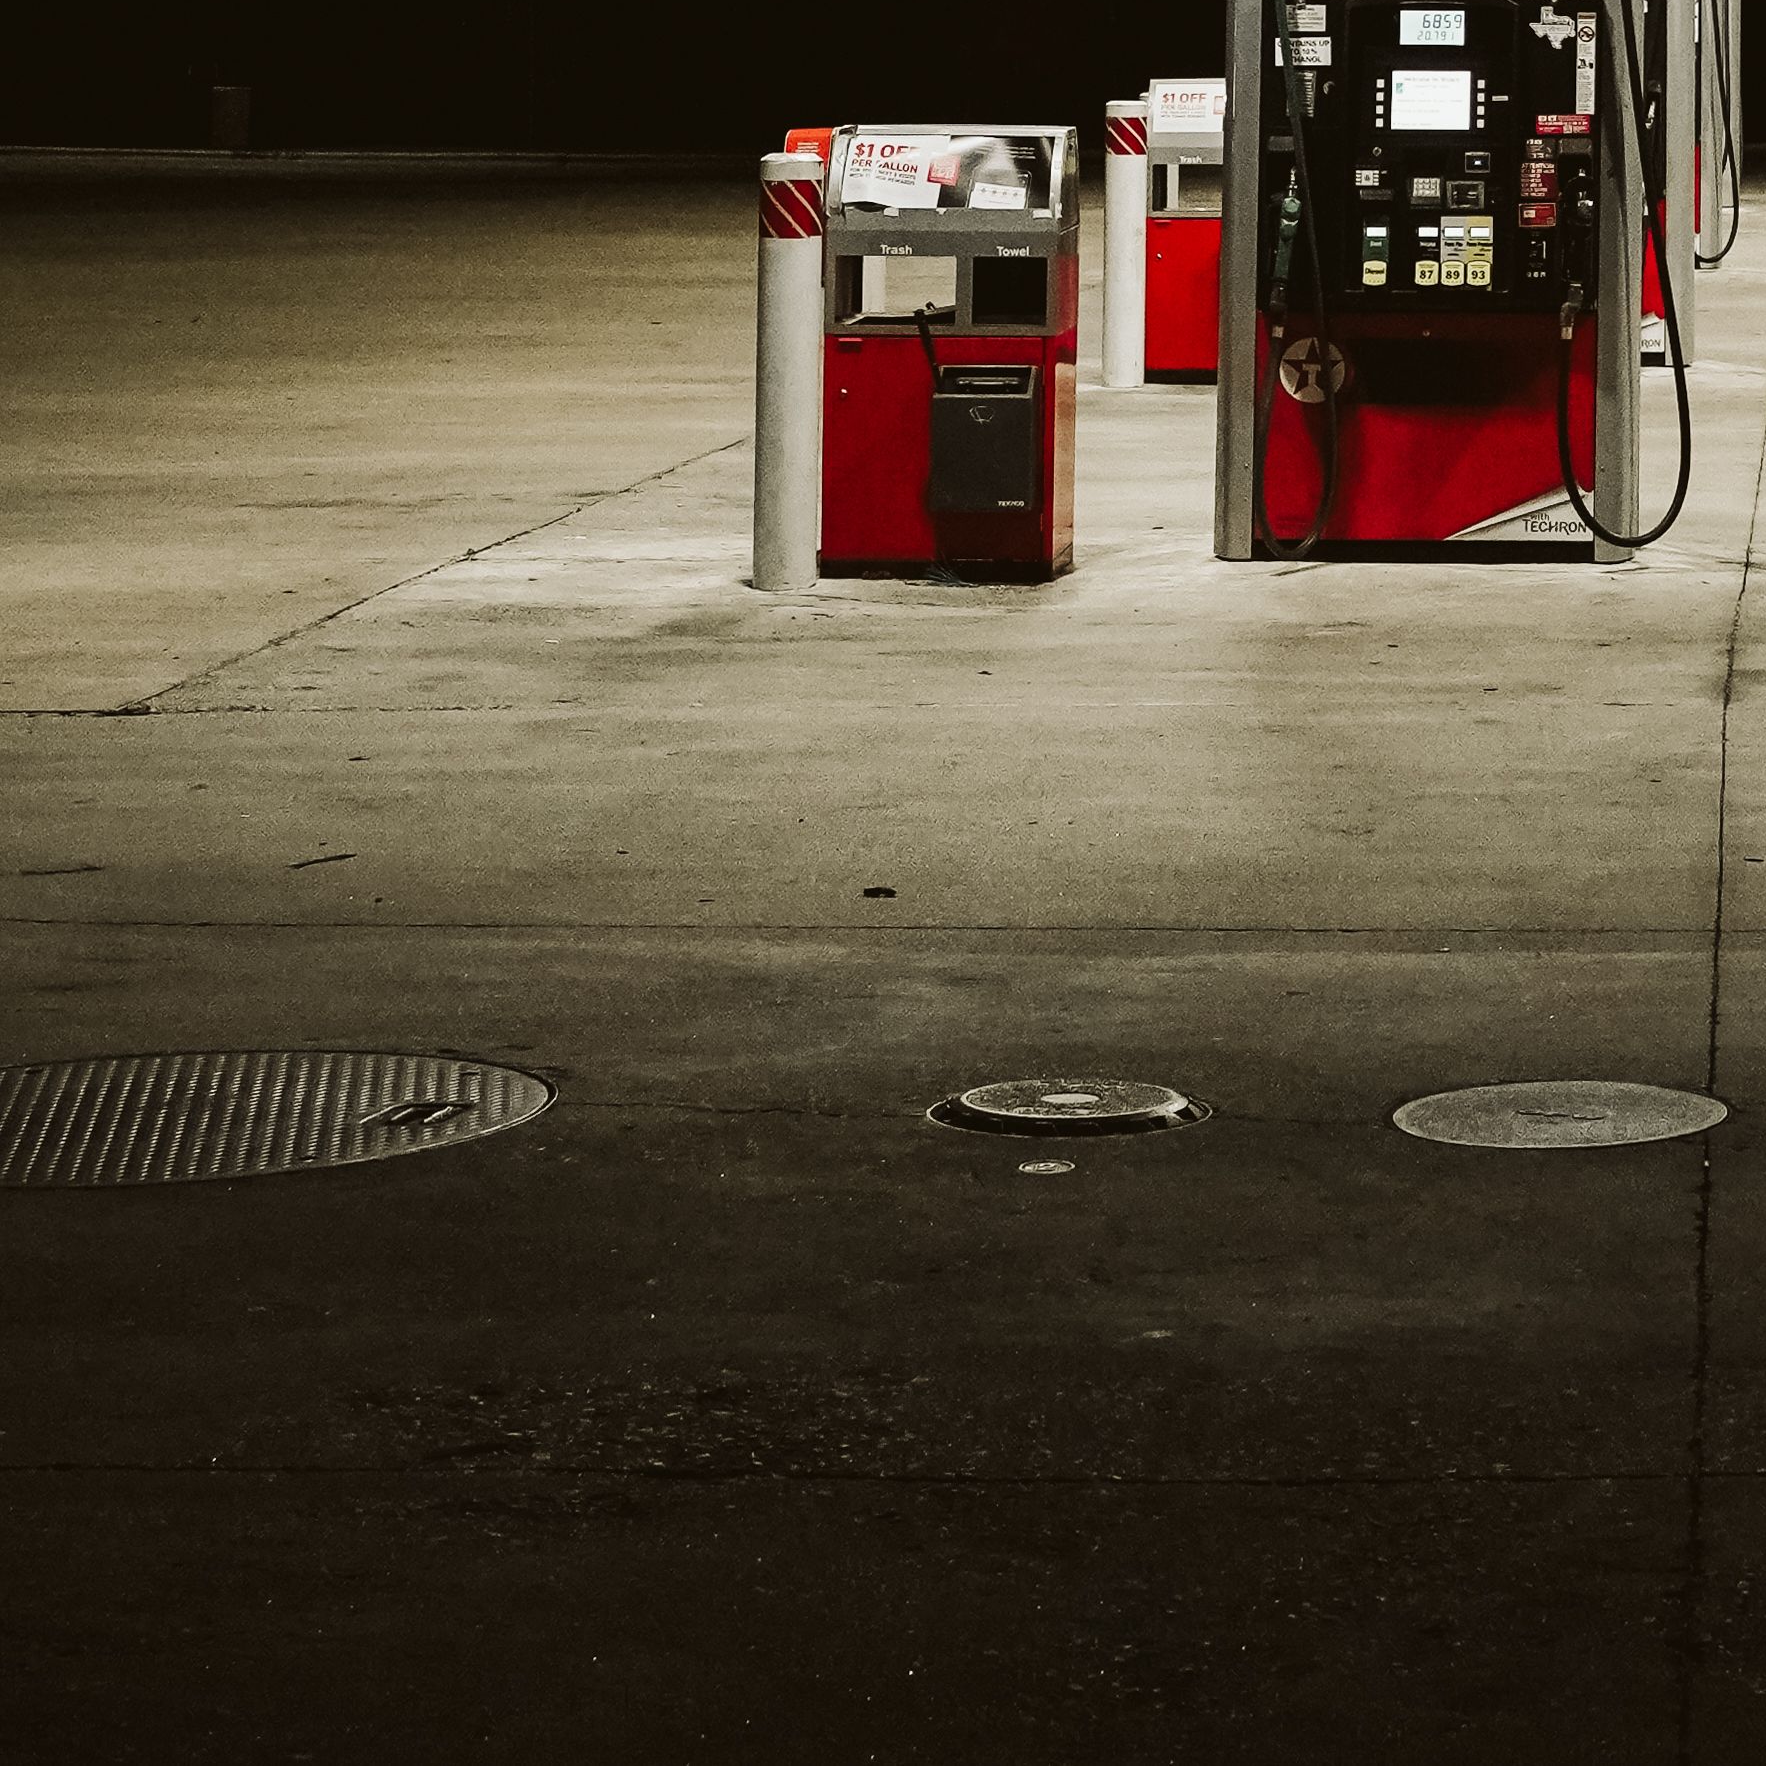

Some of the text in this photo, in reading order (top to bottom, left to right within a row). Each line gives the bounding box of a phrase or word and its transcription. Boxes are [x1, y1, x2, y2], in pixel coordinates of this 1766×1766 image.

[1162, 93, 1207, 104] $1 OFF
[854, 142, 875, 158] $1
[851, 158, 873, 167] PER
[1179, 155, 1203, 164] Trash
[879, 244, 913, 256] Trash
[996, 245, 1030, 257] Towel
[1419, 269, 1434, 279] 87
[1445, 270, 1460, 280] 89
[1471, 270, 1485, 280] 93
[1530, 513, 1550, 522] with
[1522, 518, 1588, 536] TECHRON
